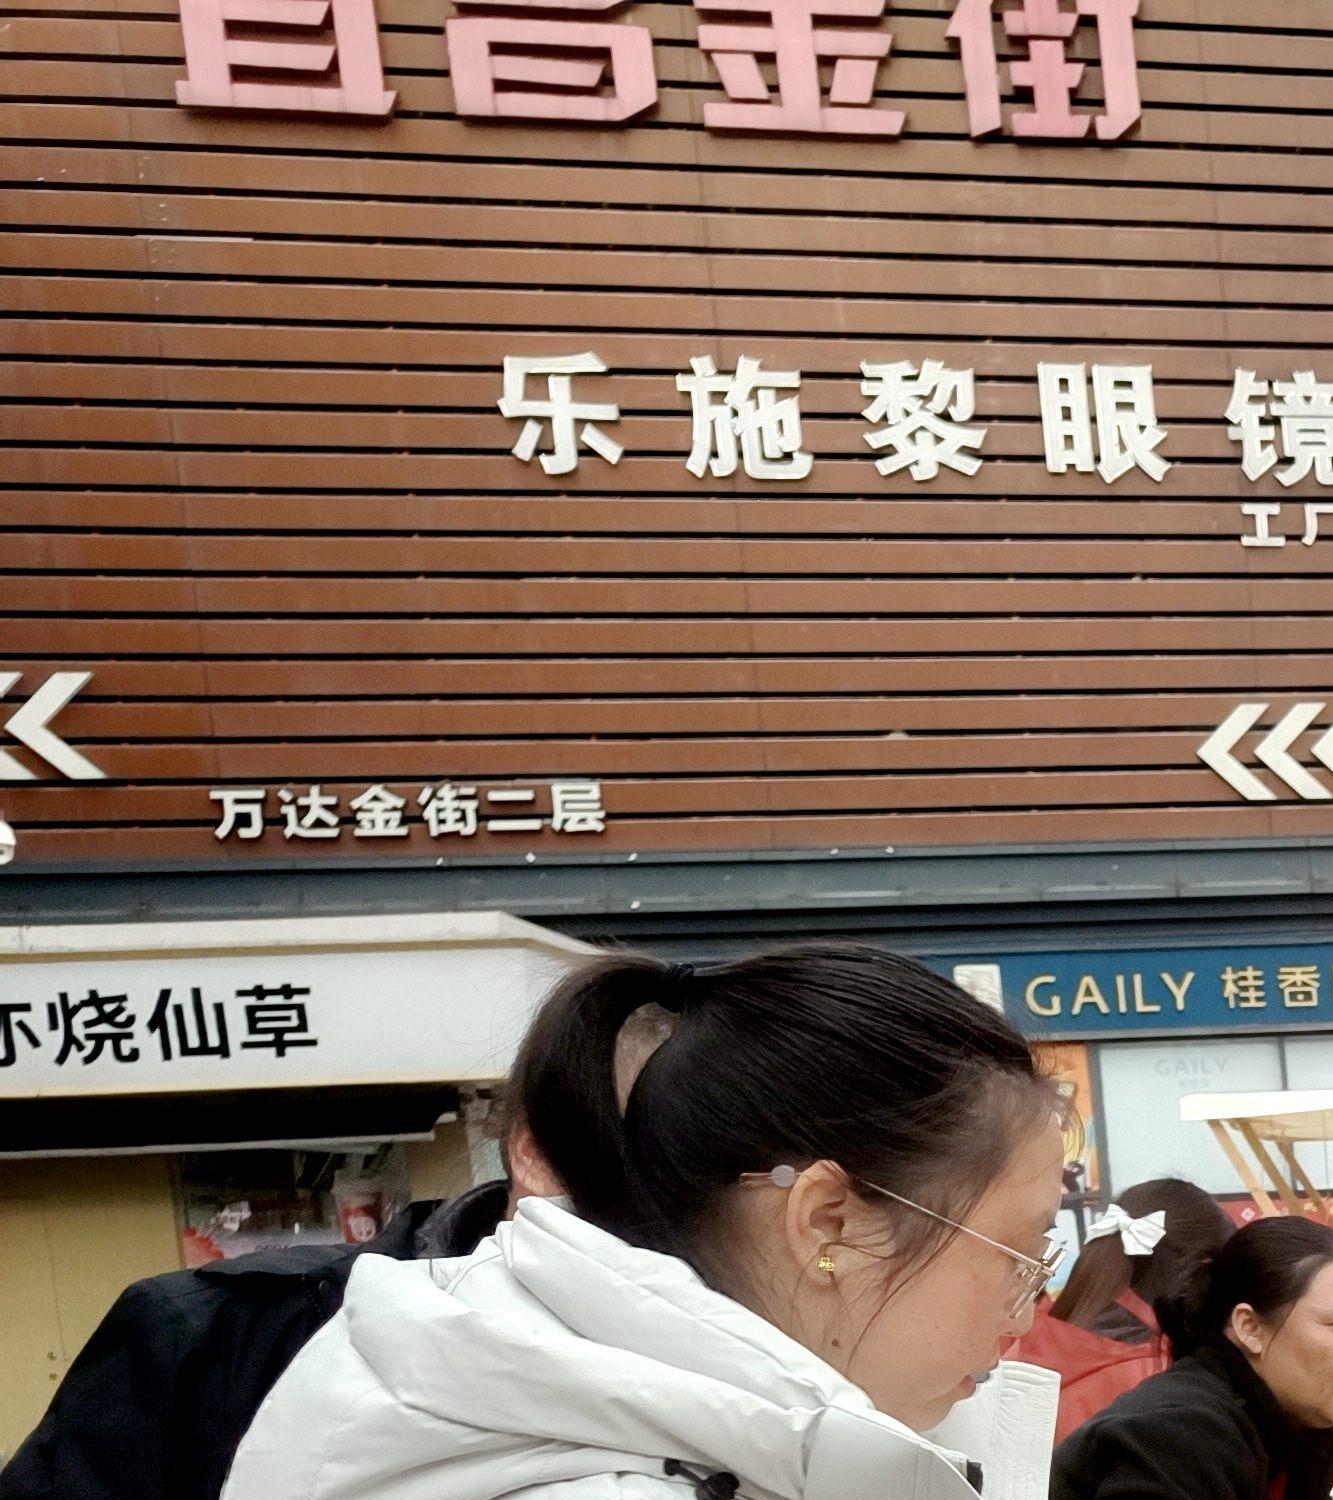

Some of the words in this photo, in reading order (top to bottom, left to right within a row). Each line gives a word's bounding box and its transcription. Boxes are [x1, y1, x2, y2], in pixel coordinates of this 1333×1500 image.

[209, 782, 607, 840] 万达金街二层
[1025, 971, 1195, 1017] GAILY
